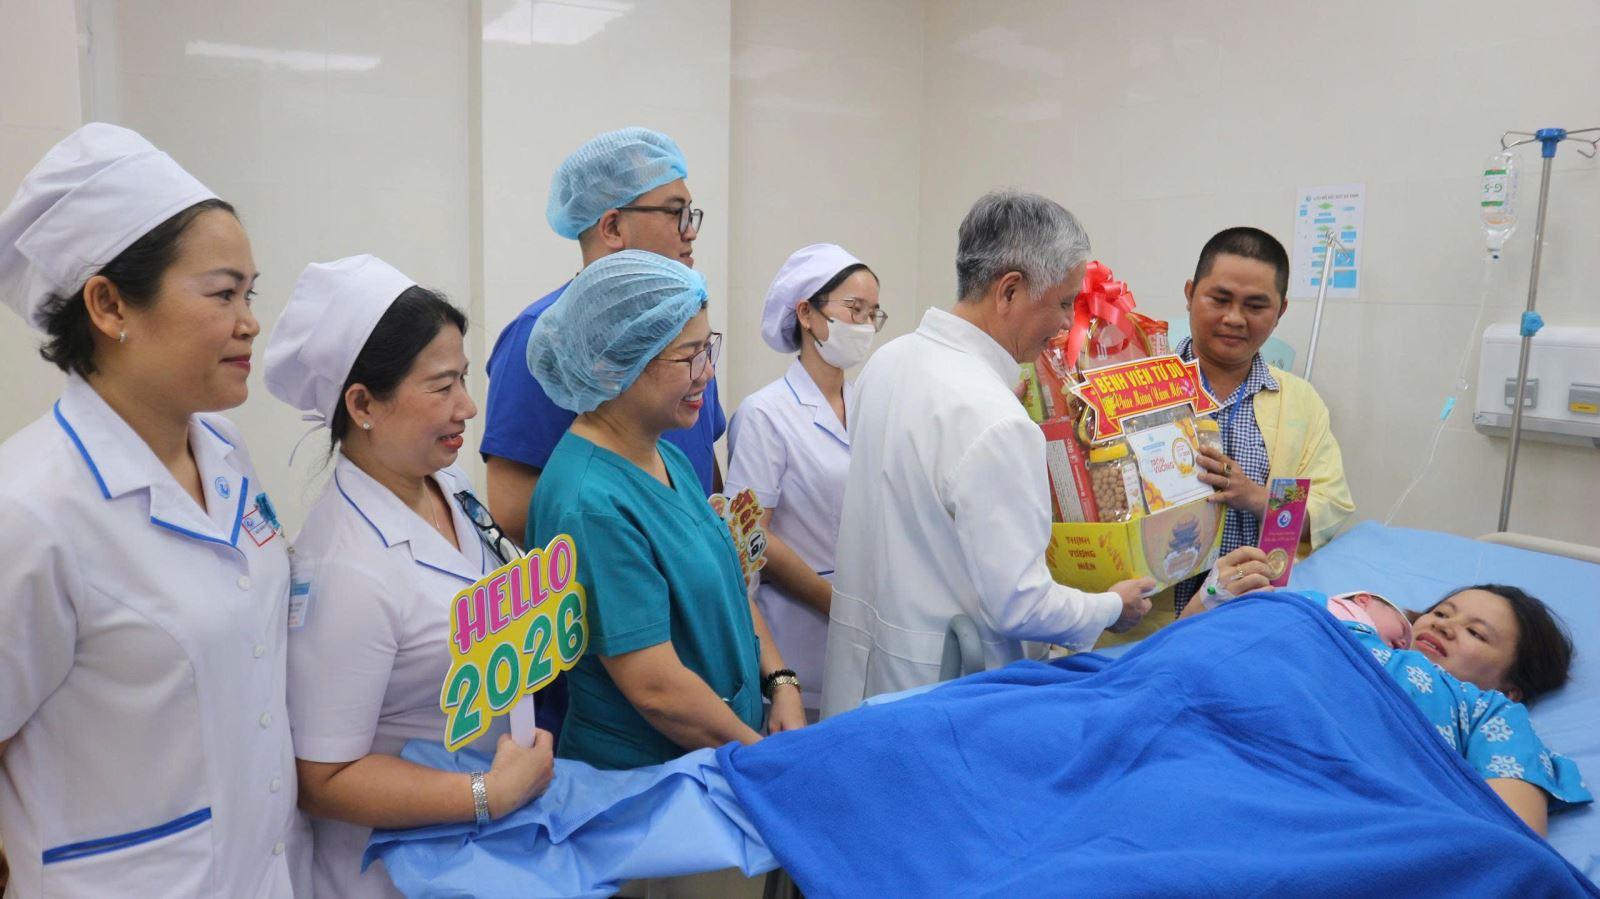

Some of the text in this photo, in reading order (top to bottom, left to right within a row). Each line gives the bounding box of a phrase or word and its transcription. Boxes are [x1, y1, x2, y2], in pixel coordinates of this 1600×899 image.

[1095, 359, 1185, 394] BỆNH VIỆN TỪ DŨ
[454, 539, 572, 654] HELLO
[446, 591, 584, 745] 2026
